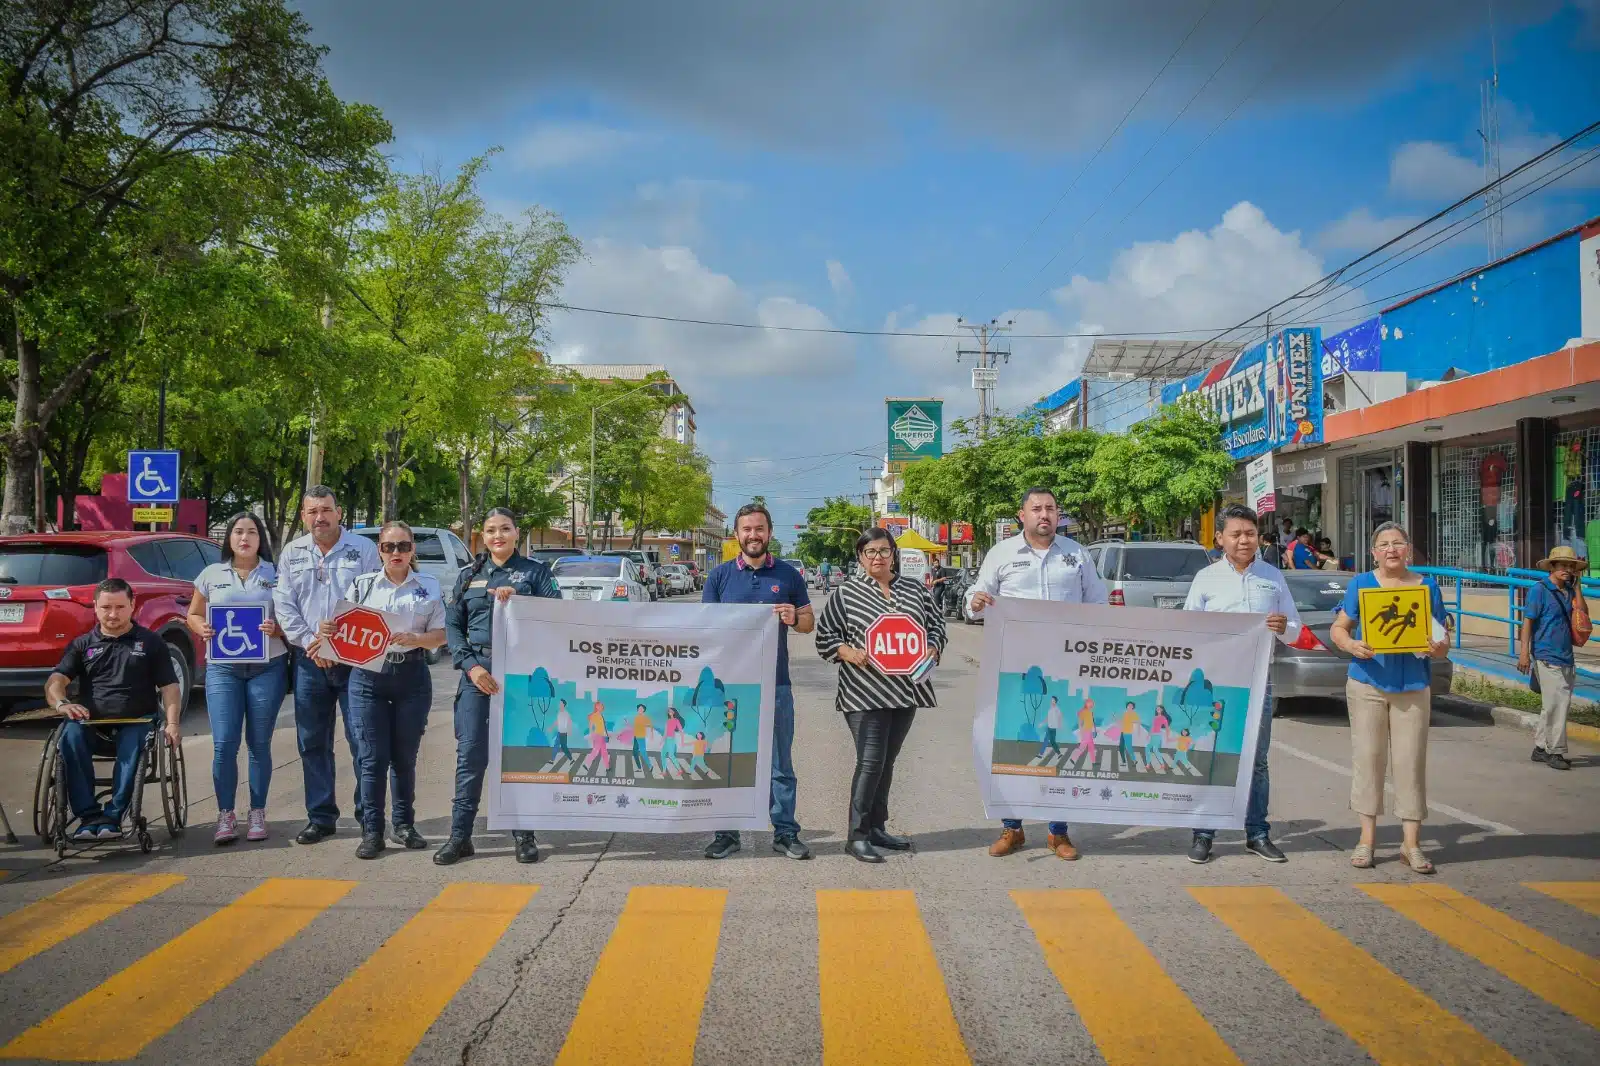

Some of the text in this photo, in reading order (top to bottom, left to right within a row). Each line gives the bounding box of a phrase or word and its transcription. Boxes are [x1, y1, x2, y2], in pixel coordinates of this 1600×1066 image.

[1233, 425, 1266, 447] Escolares
[333, 622, 384, 650] ALTO
[874, 632, 919, 655] ALTO
[569, 640, 700, 658] LOS PEATONES
[1064, 640, 1193, 660] LOS PEATONES
[596, 656, 672, 667] SIEMPRE TIENEN
[1090, 656, 1165, 667] SIEMPRE TIENEN
[586, 665, 682, 682] PRIORIDAD
[1079, 665, 1172, 682] PRIORIDAD
[1087, 770, 1095, 778] EL
[648, 798, 678, 806] IMPLAN
[1130, 791, 1159, 799] IMPLAN
